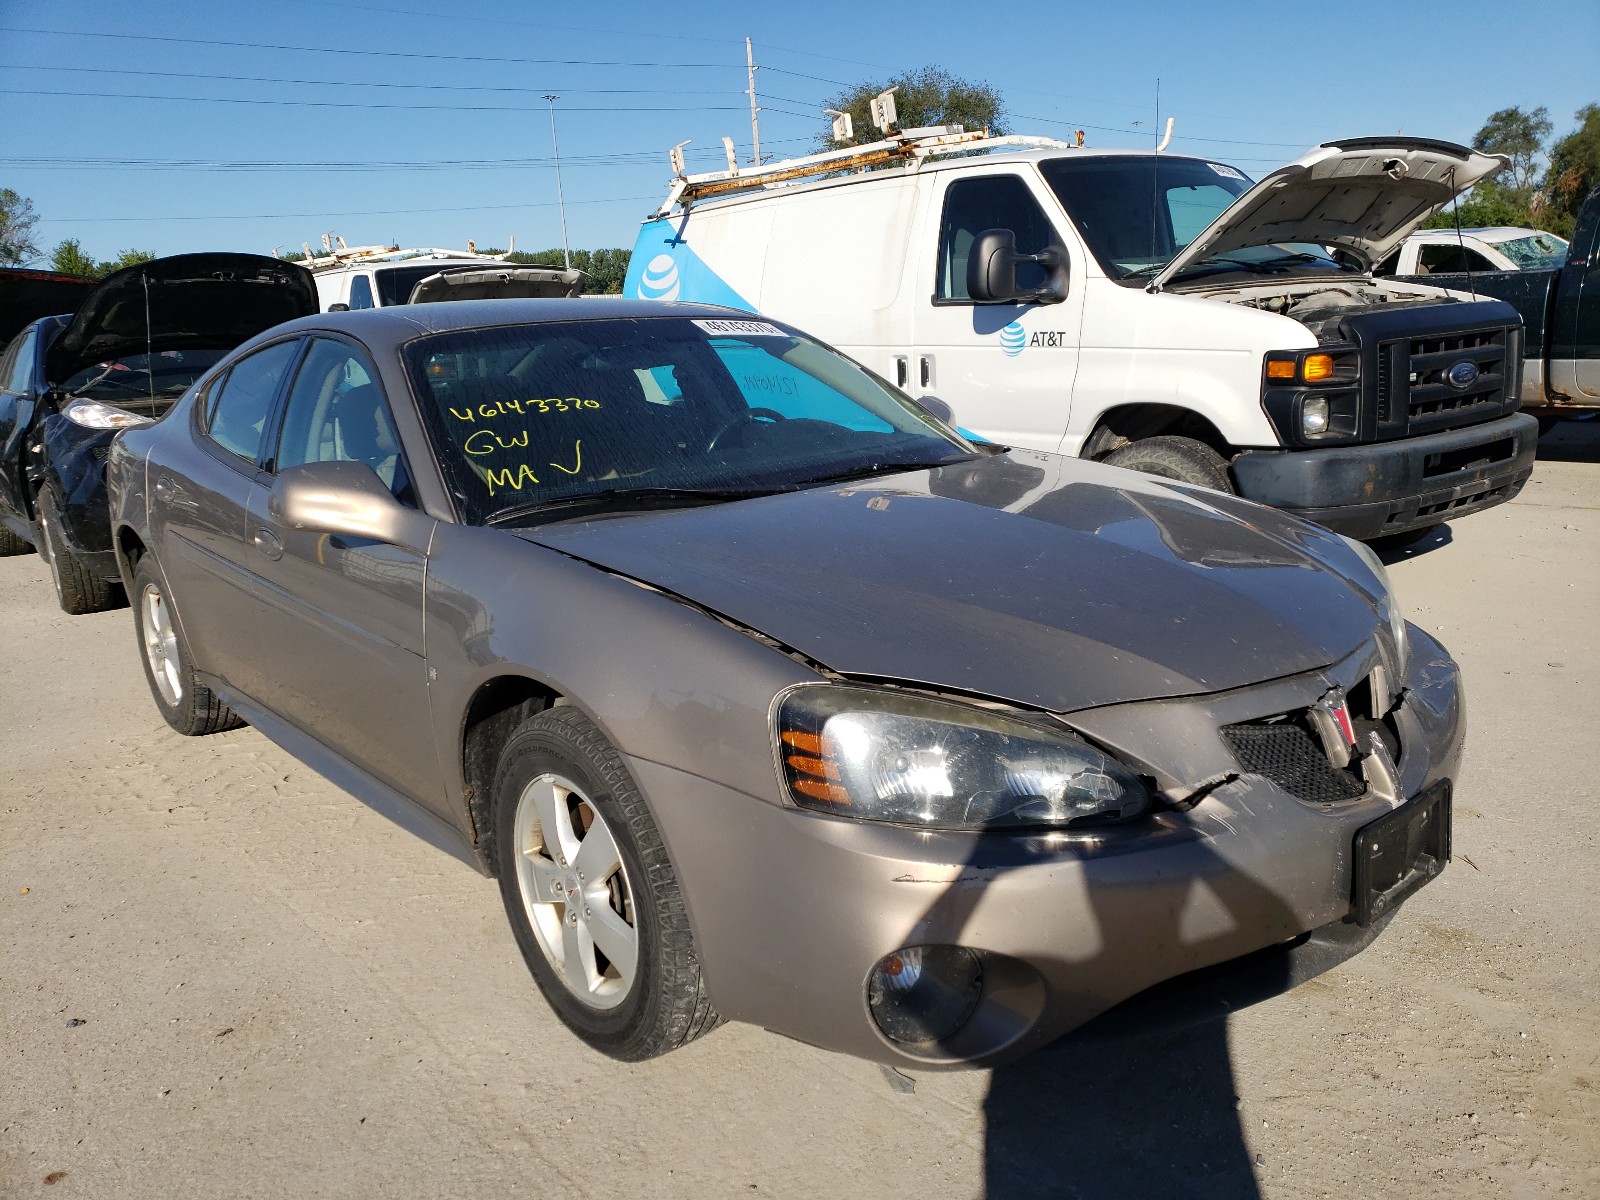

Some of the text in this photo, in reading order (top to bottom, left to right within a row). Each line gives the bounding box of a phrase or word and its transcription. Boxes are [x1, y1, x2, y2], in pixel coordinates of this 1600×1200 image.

[1030, 331, 1066, 347] AT&T
[449, 397, 601, 422] 46143370
[464, 430, 528, 455] GW
[487, 464, 539, 496] MA
